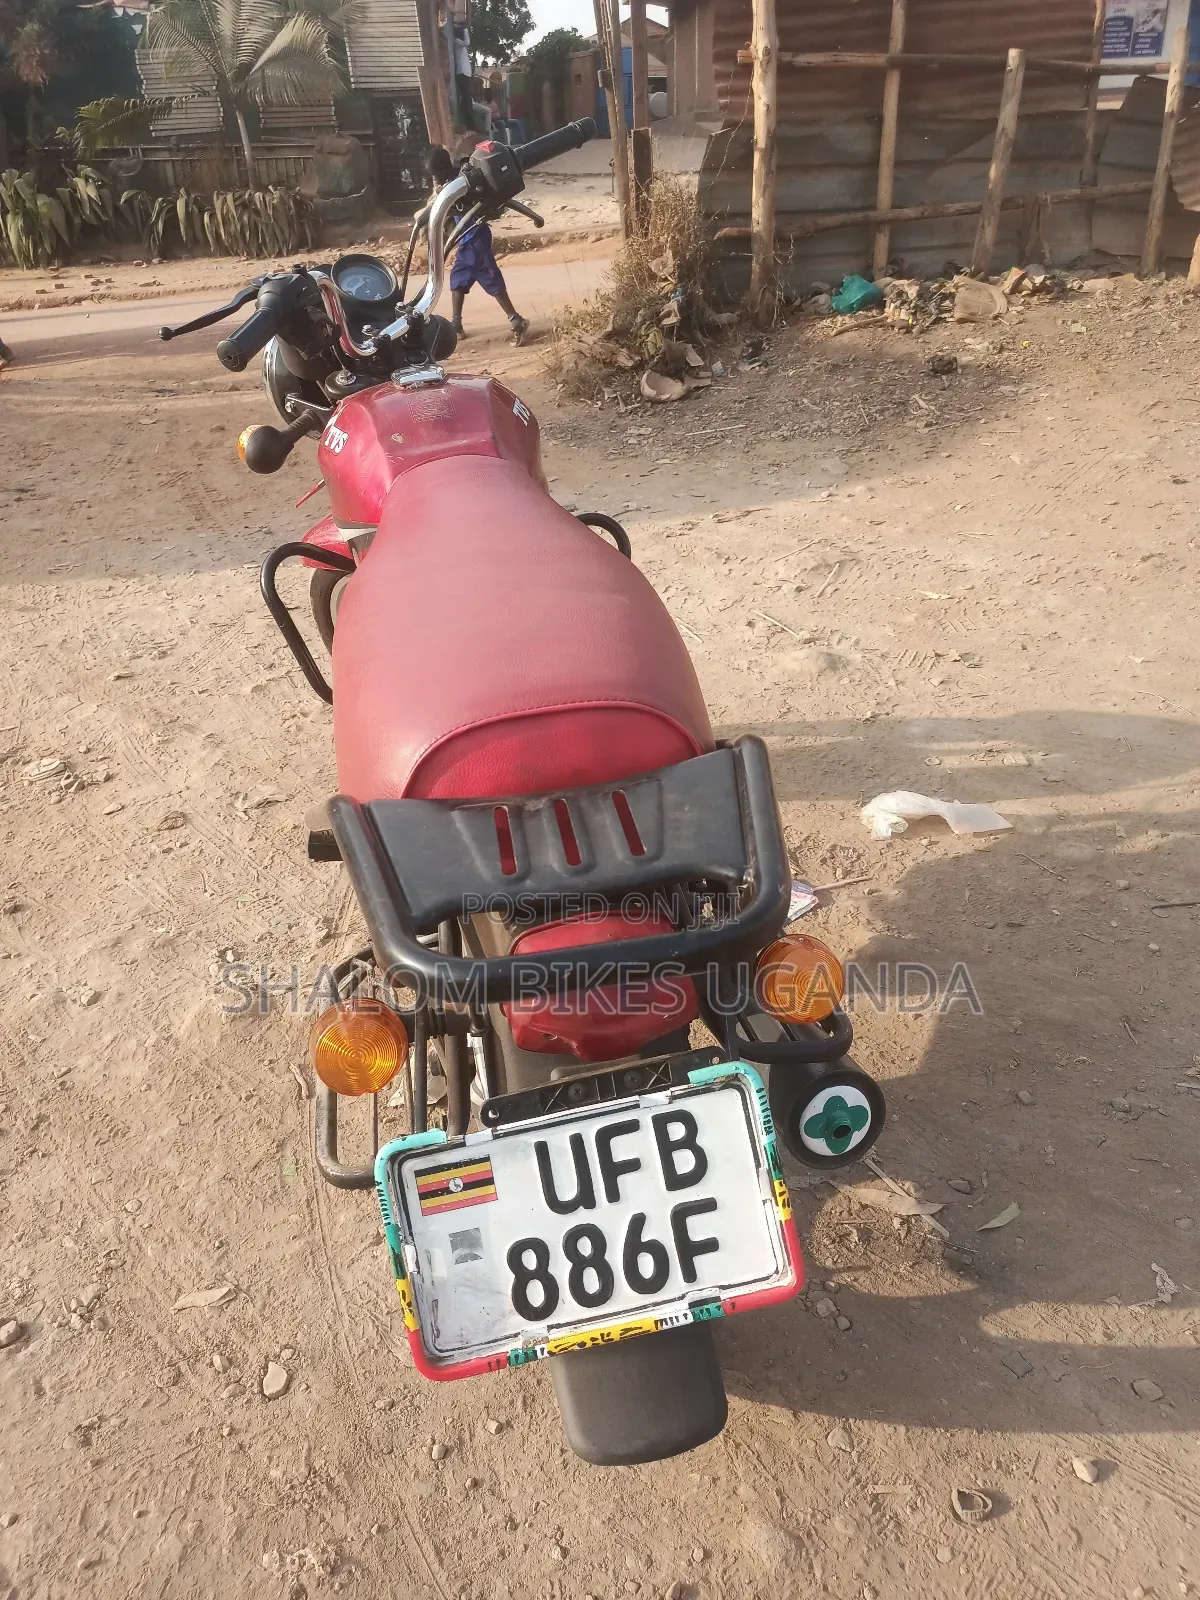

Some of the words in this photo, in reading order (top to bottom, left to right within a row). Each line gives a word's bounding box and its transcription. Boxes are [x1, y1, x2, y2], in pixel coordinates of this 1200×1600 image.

[324, 425, 349, 454] TVS
[534, 1109, 709, 1215] UFB
[507, 1197, 720, 1322] 886F
